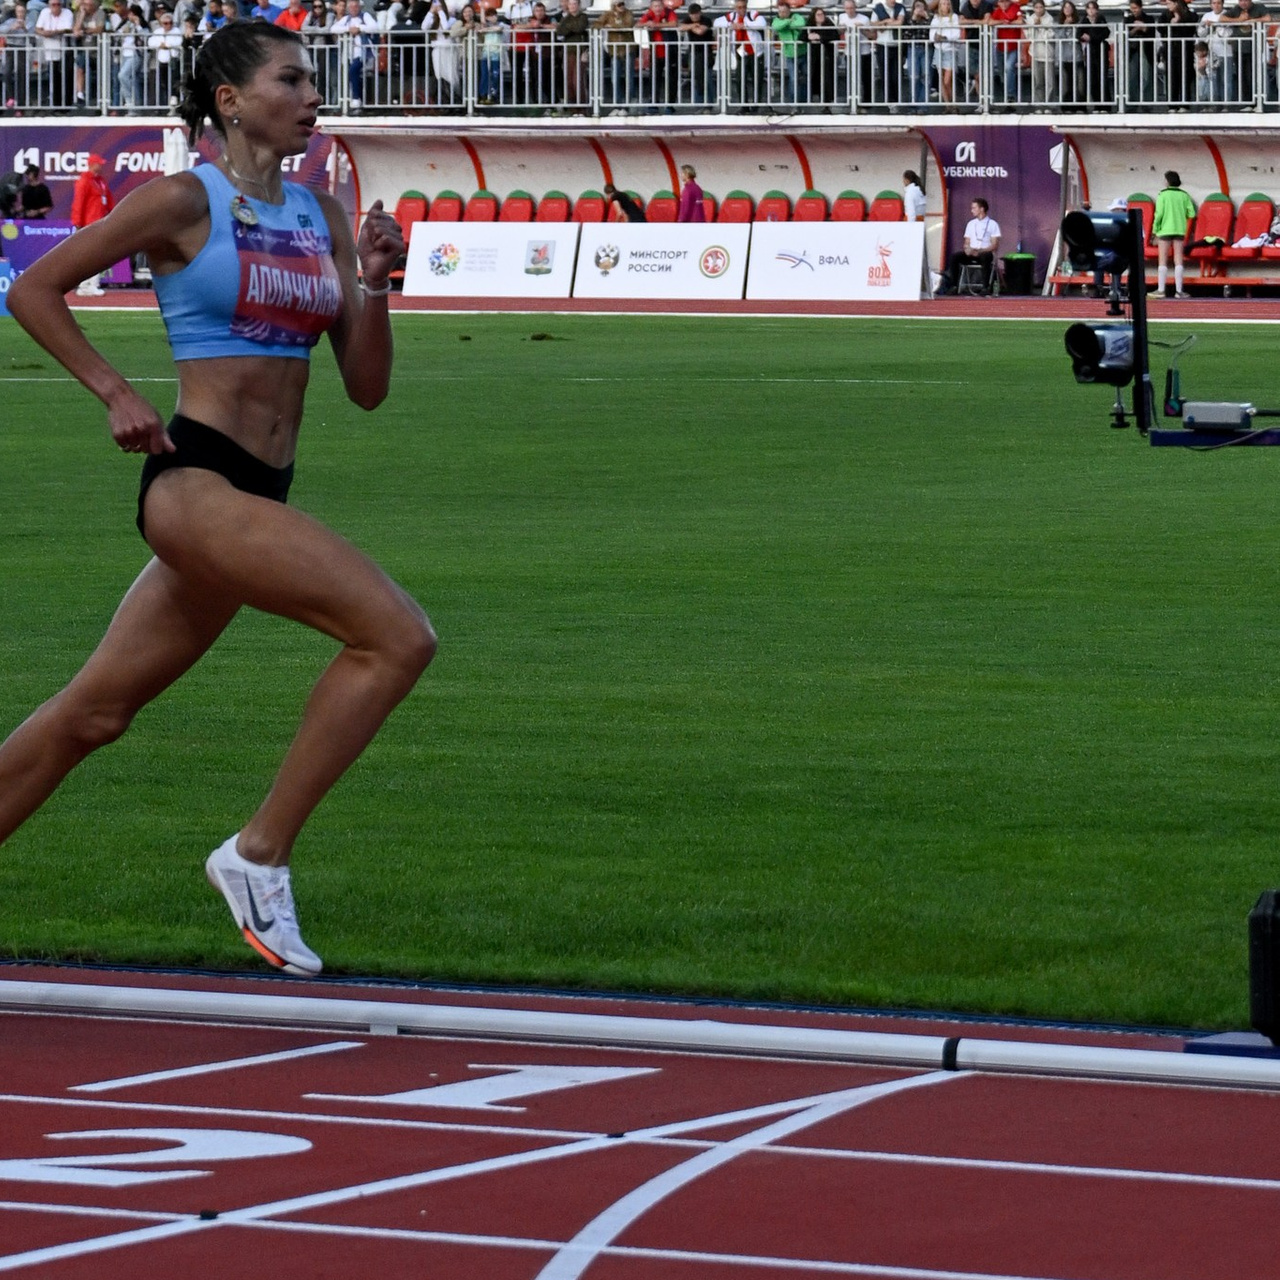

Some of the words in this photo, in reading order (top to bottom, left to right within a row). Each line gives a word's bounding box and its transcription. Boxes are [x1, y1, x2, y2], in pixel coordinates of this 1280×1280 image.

[44, 151, 90, 173] ПСБ
[114, 151, 200, 173] FONT
[629, 250, 688, 260] МИНСПОРТ
[818, 255, 850, 266] ВФЛА
[627, 263, 672, 273] РОССИИ
[868, 266, 881, 279] 80
